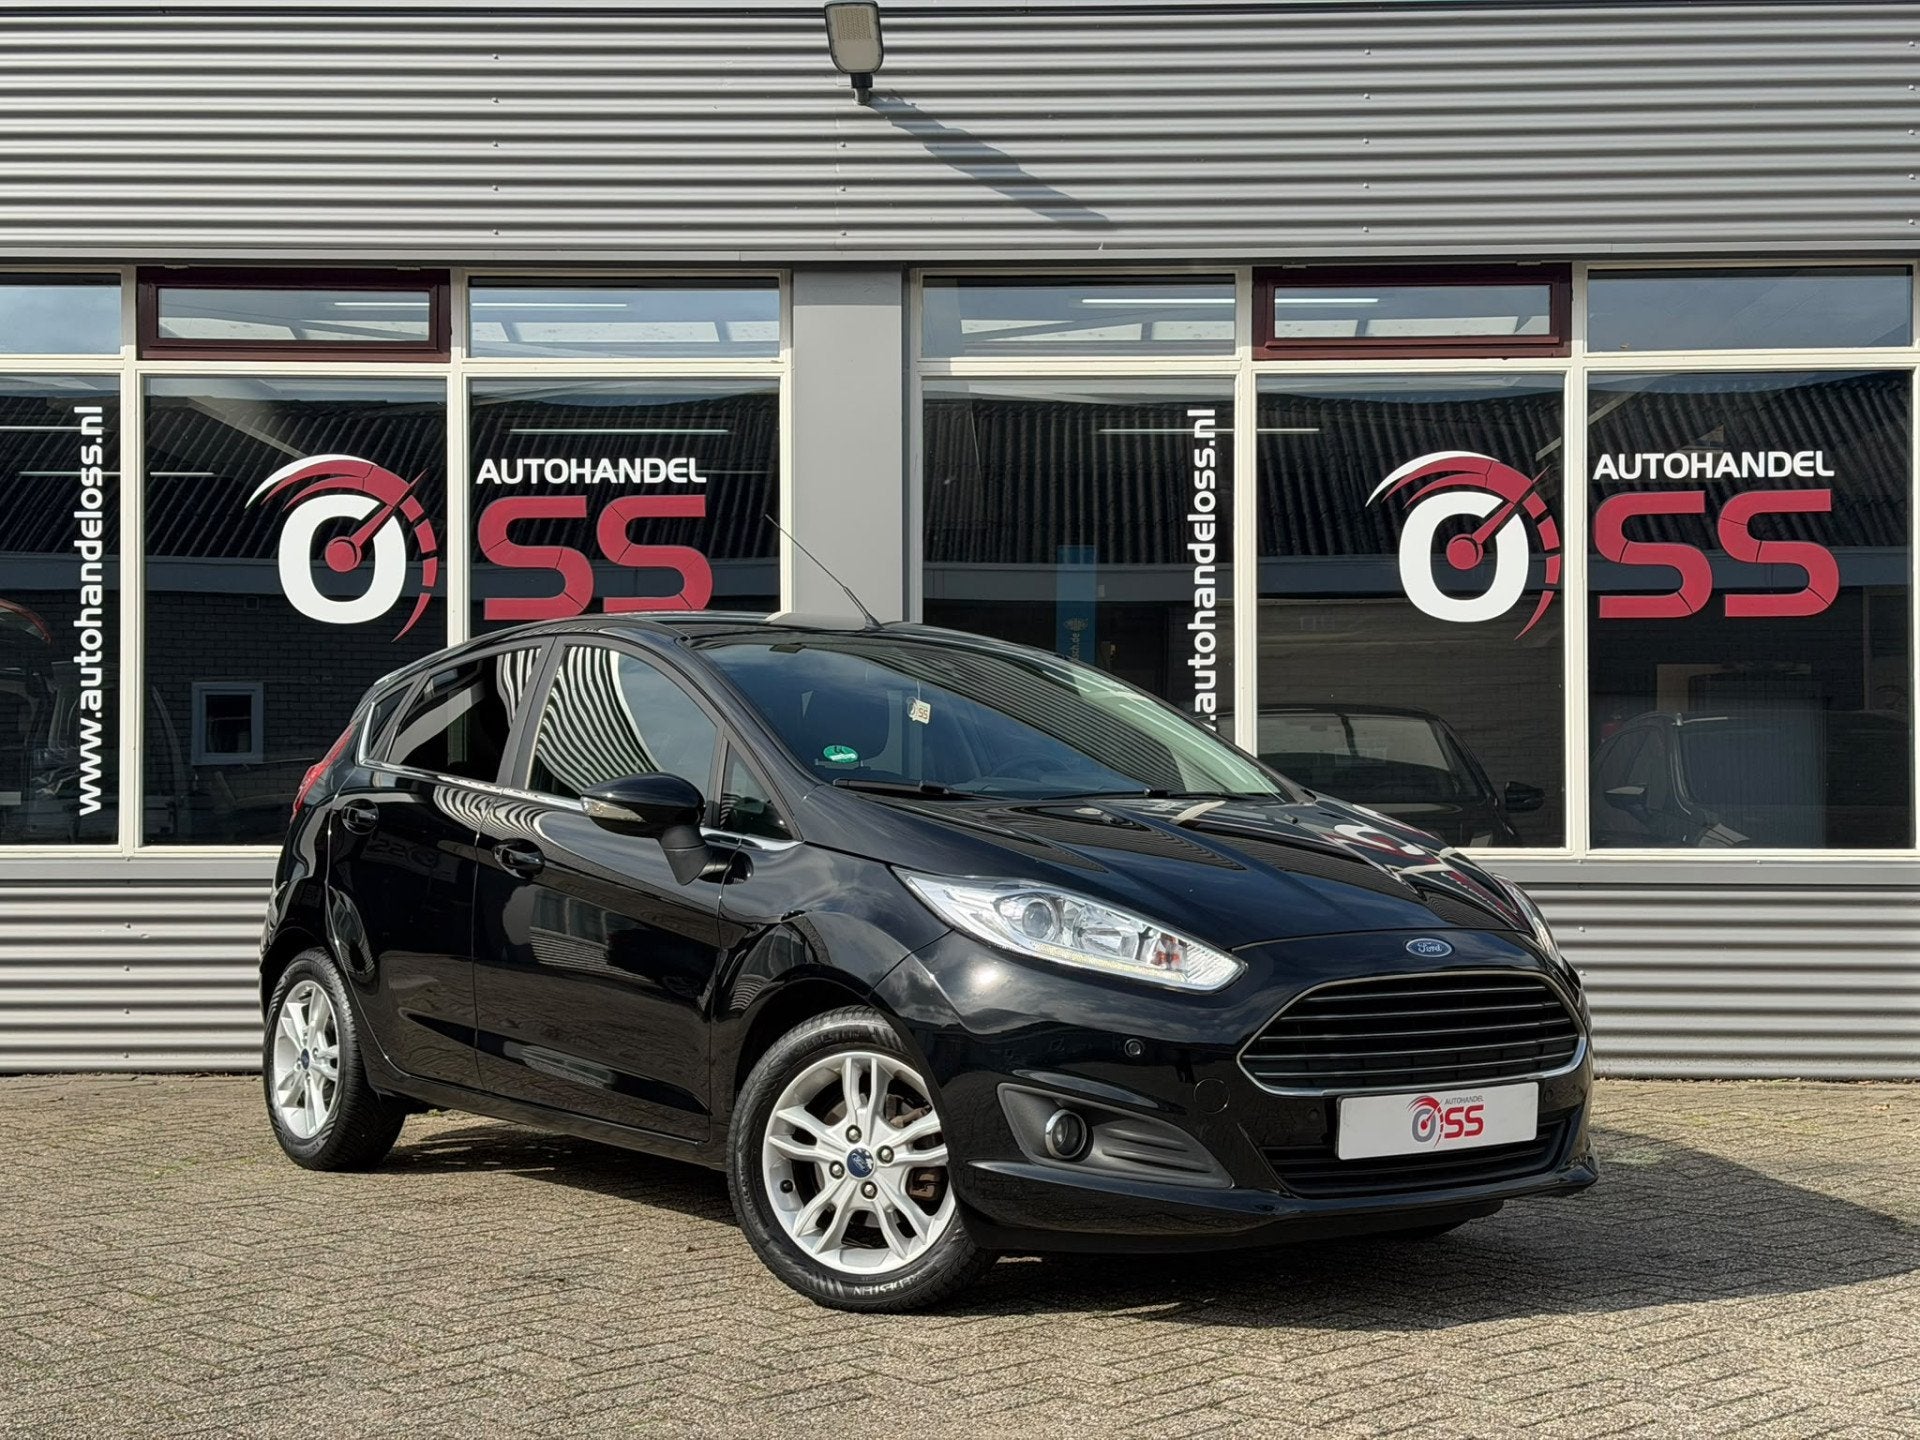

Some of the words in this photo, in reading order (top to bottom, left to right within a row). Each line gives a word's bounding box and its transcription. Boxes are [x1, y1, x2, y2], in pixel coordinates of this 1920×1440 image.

[476, 457, 707, 485] AUTOHANDEL
[1592, 450, 1835, 480] AUTOHANDEL
[73, 406, 103, 816] www.autohandeloss.nl
[1417, 942, 1443, 953] Ford
